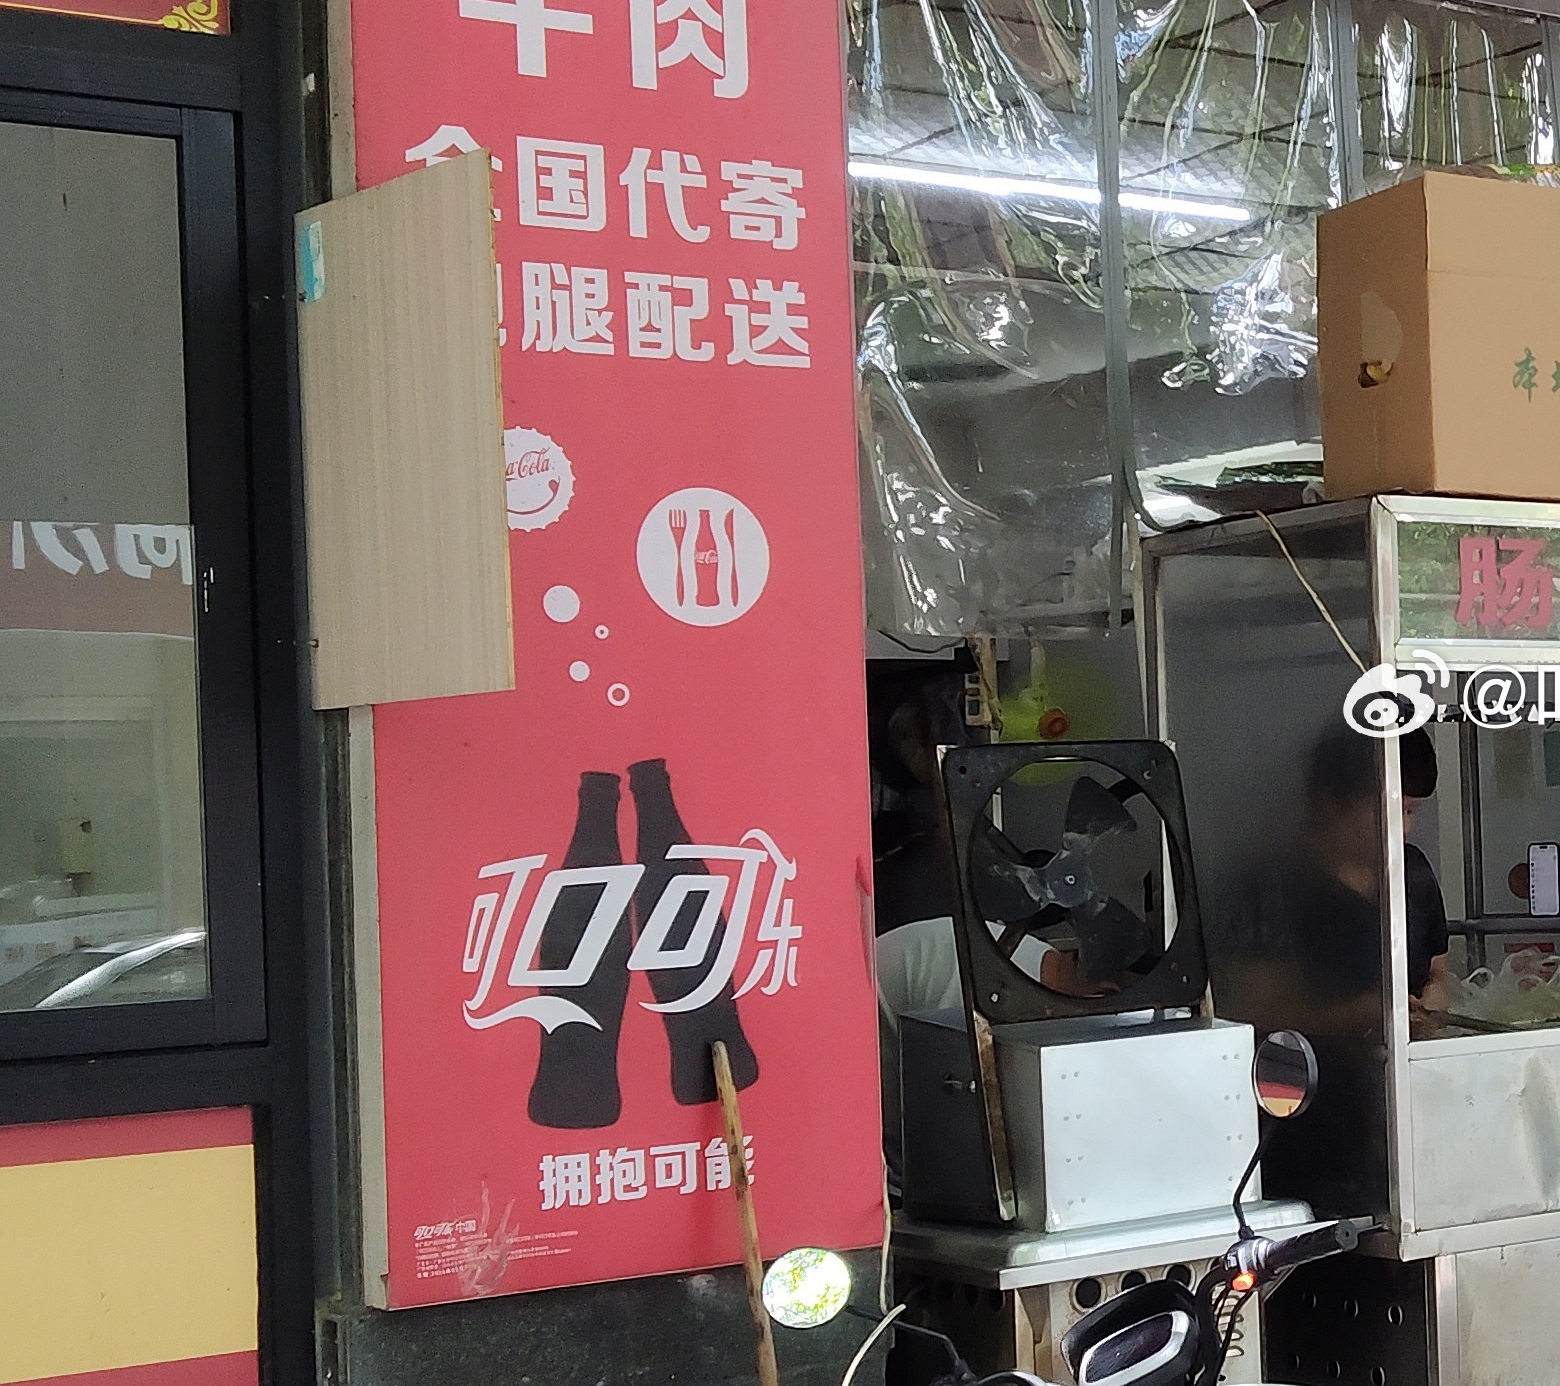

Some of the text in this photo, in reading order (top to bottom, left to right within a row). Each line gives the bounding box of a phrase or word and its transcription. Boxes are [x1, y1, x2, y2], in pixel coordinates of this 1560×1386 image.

[496, 261, 811, 368] 腿配送
[463, 828, 802, 1034] 可口可乐
[538, 1135, 756, 1210] 拥抱可能
